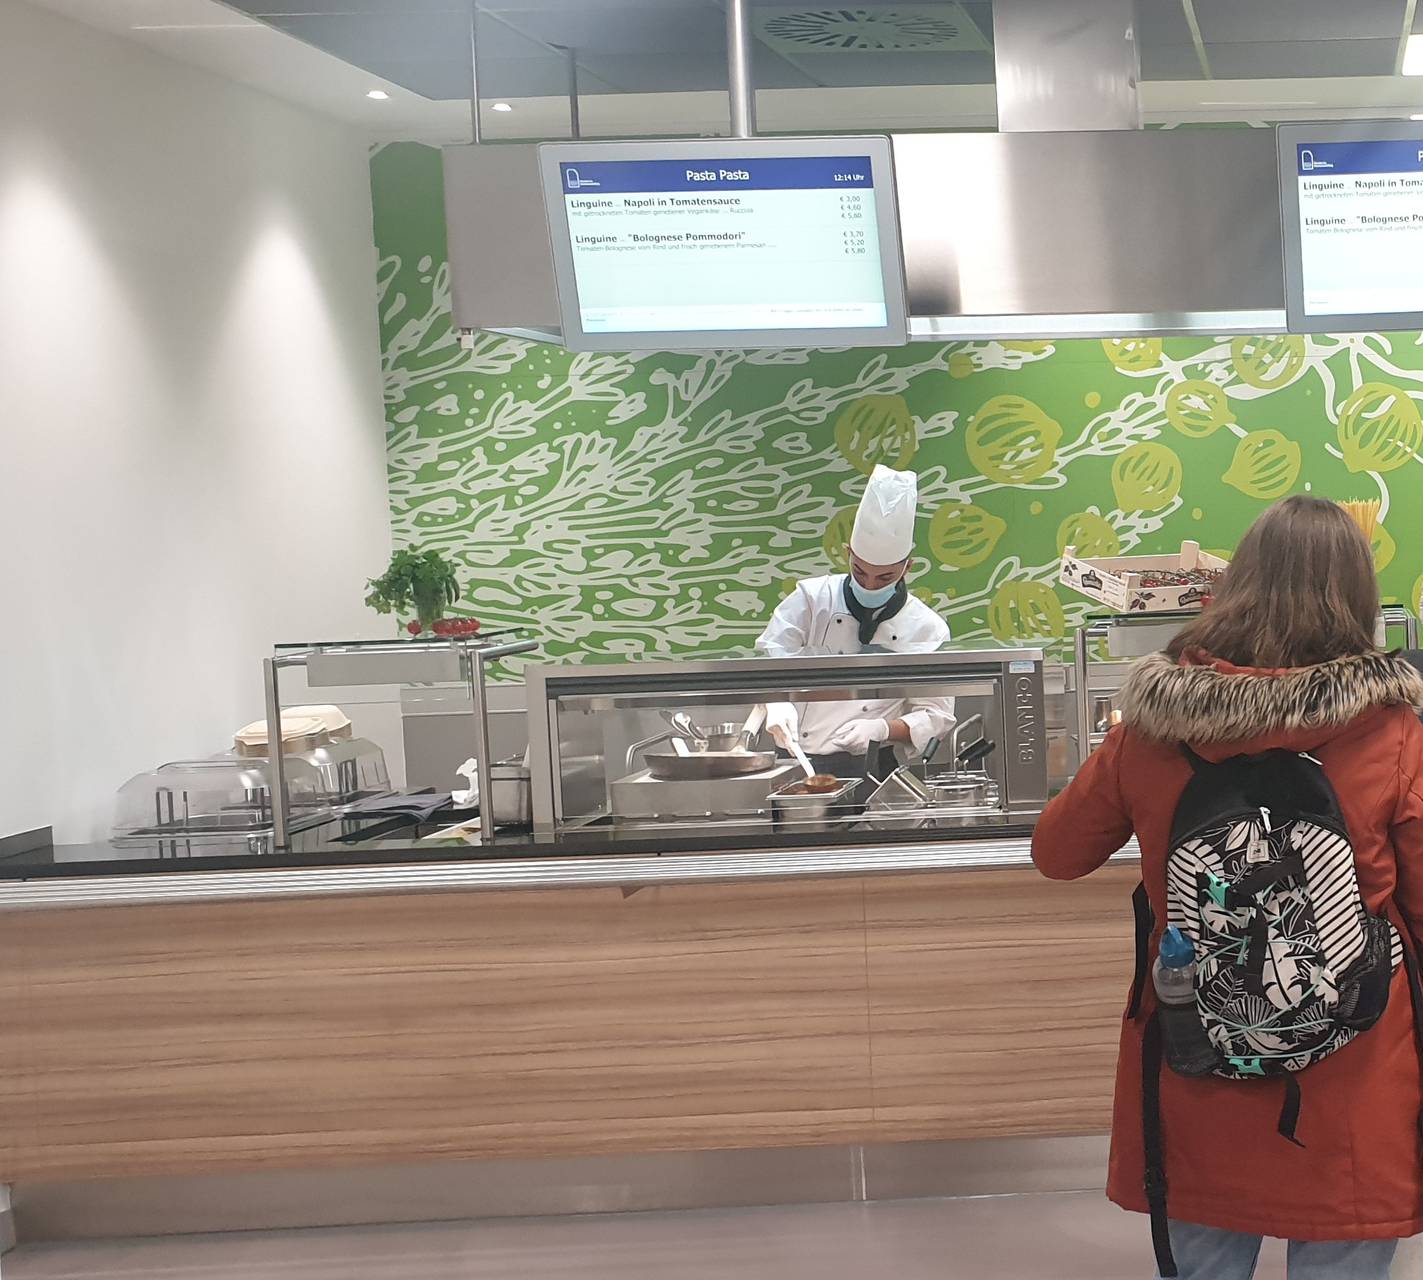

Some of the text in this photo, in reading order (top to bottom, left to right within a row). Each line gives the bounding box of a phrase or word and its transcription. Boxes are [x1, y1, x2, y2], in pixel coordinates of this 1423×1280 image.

[686, 169, 750, 182] Pasta Pasta
[834, 174, 852, 182] 12:14
[1303, 181, 1345, 192] Linguine
[1355, 179, 1385, 190] Napoli
[1388, 179, 1397, 188] in
[571, 199, 613, 210] Linguine
[624, 198, 655, 208] Napoli
[657, 198, 667, 206] in
[670, 197, 741, 206] Tomatensauce
[1305, 217, 1346, 227] Linguine
[1356, 215, 1410, 226] "Bolognese
[576, 232, 746, 244] Linguine "Bolognese Pommodori"
[1016, 676, 1036, 765] BLANCO
